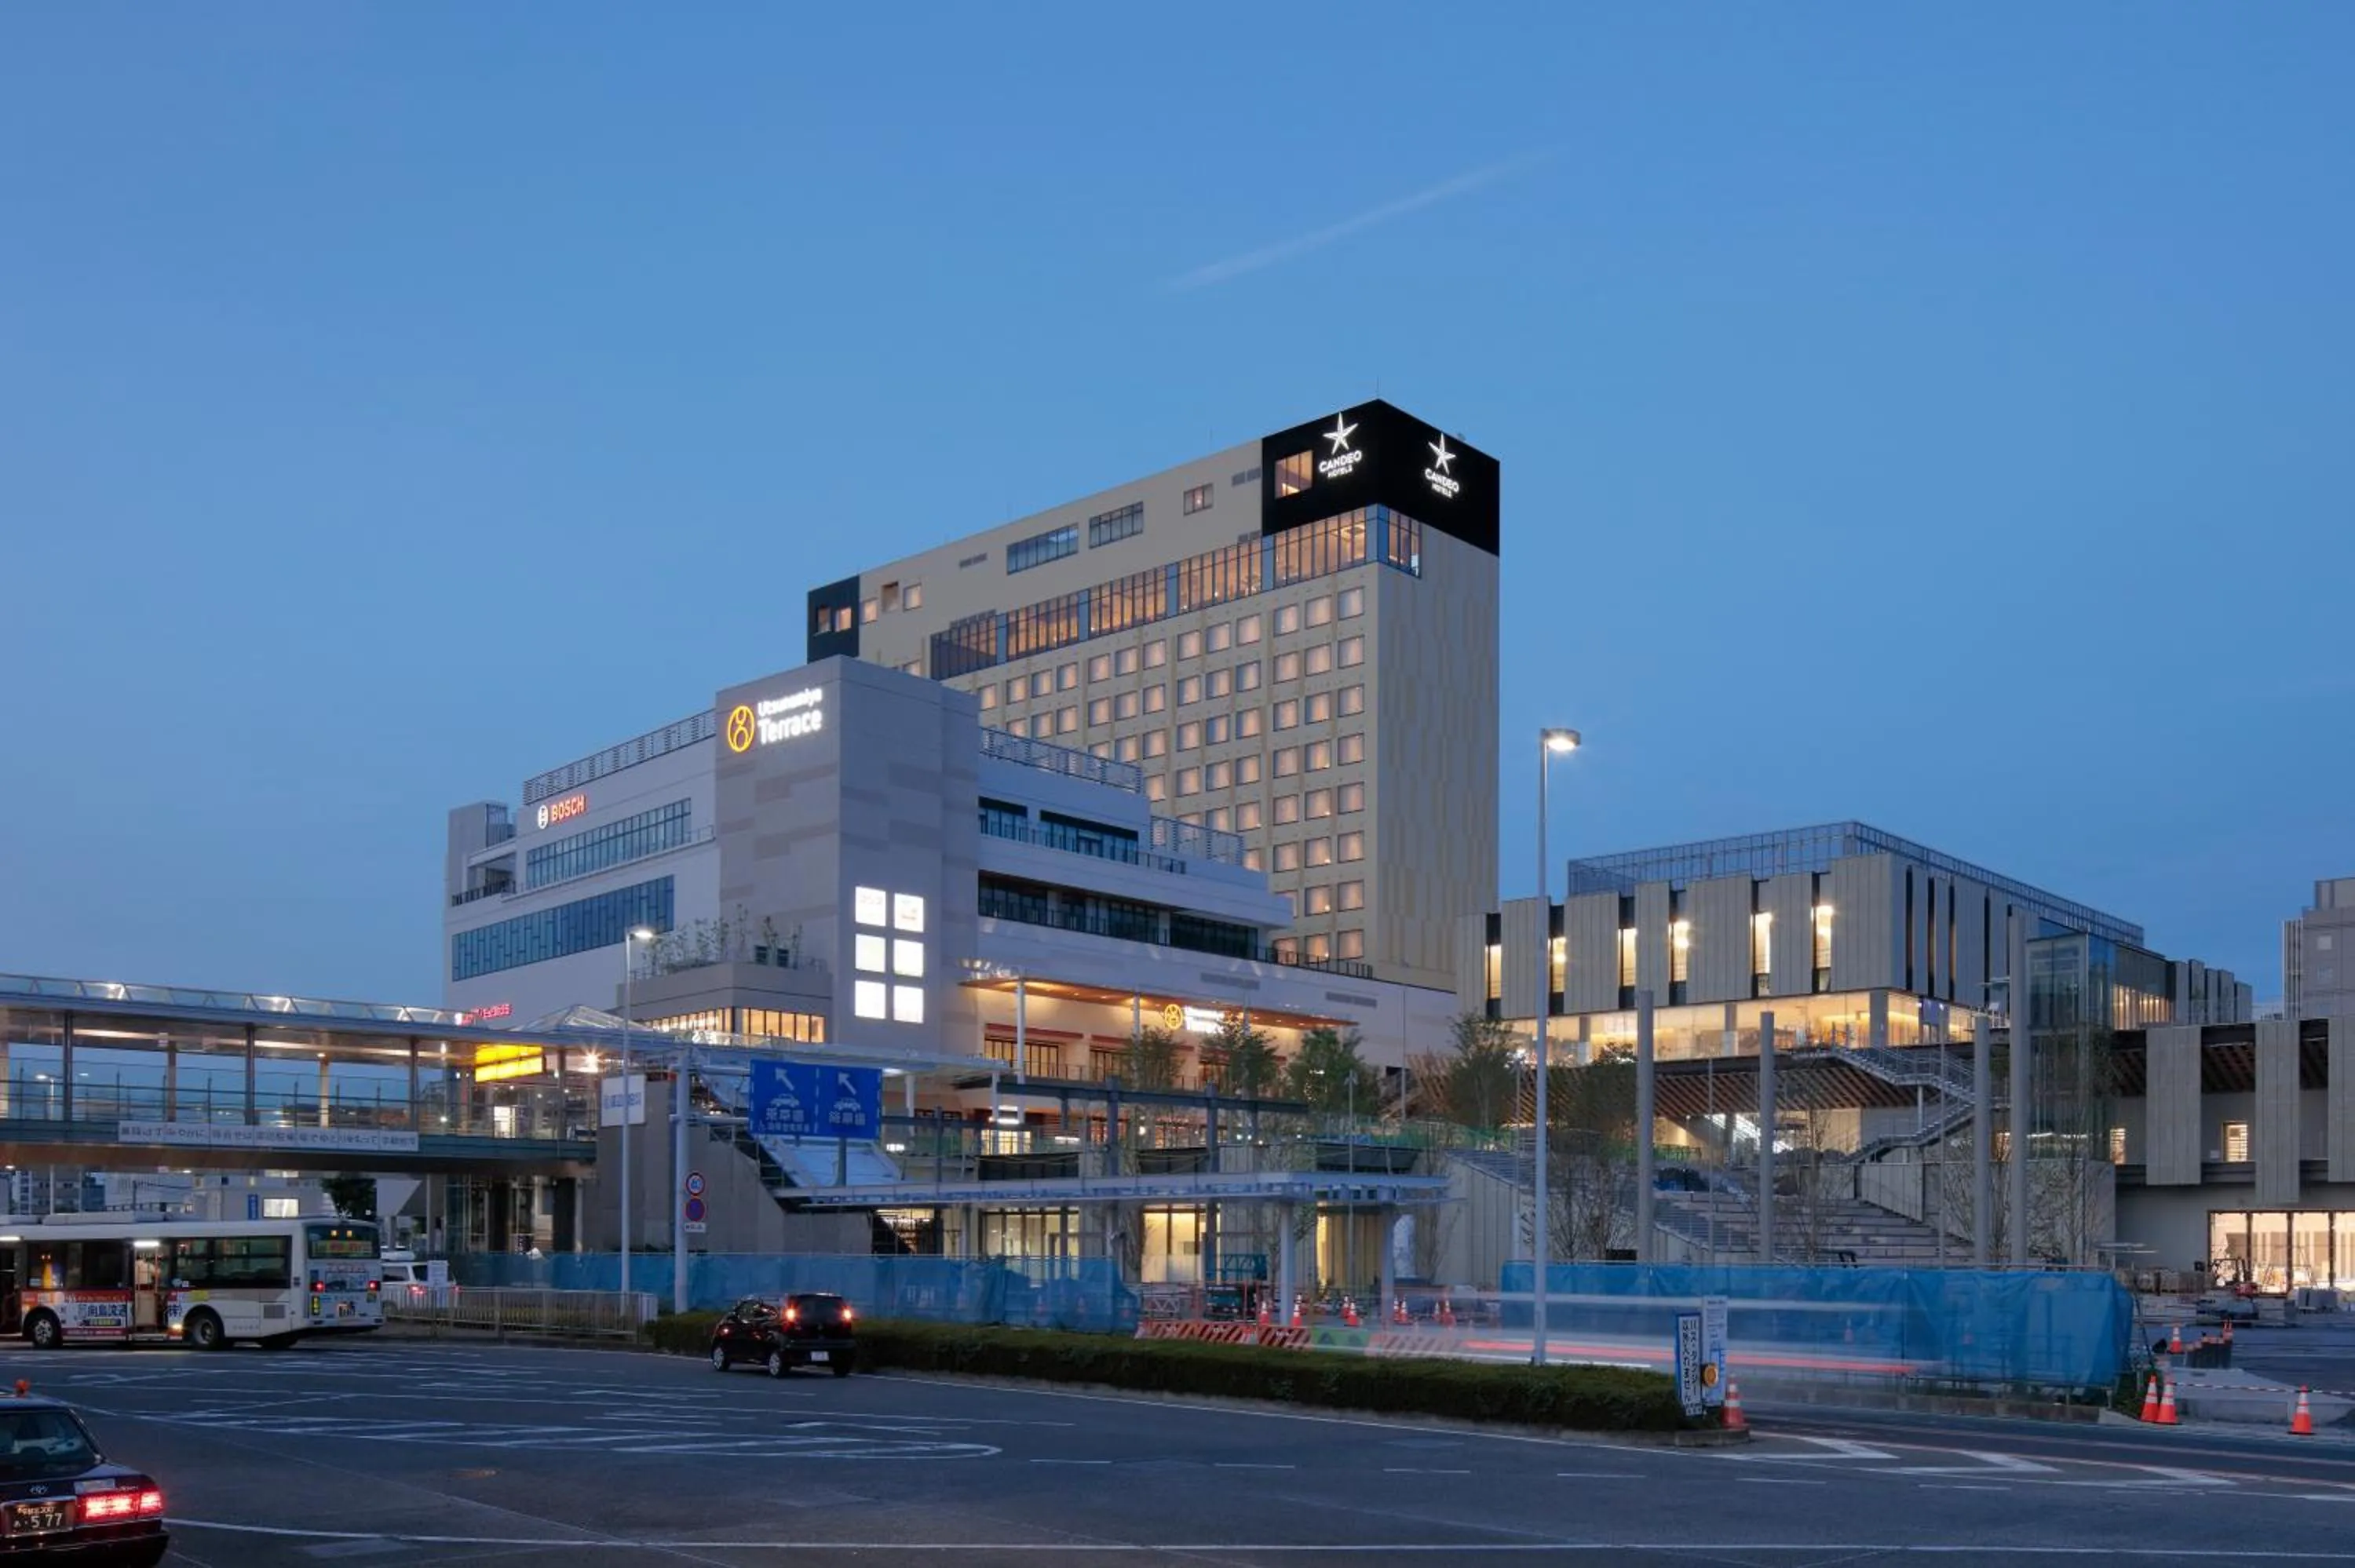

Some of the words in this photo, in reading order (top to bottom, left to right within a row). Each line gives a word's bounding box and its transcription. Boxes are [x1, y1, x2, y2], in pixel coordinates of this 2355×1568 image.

[1319, 450, 1362, 472] CANDEO
[1425, 468, 1459, 493] CANDEO
[758, 709, 822, 745] Terrace
[551, 794, 586, 822] BOSCH
